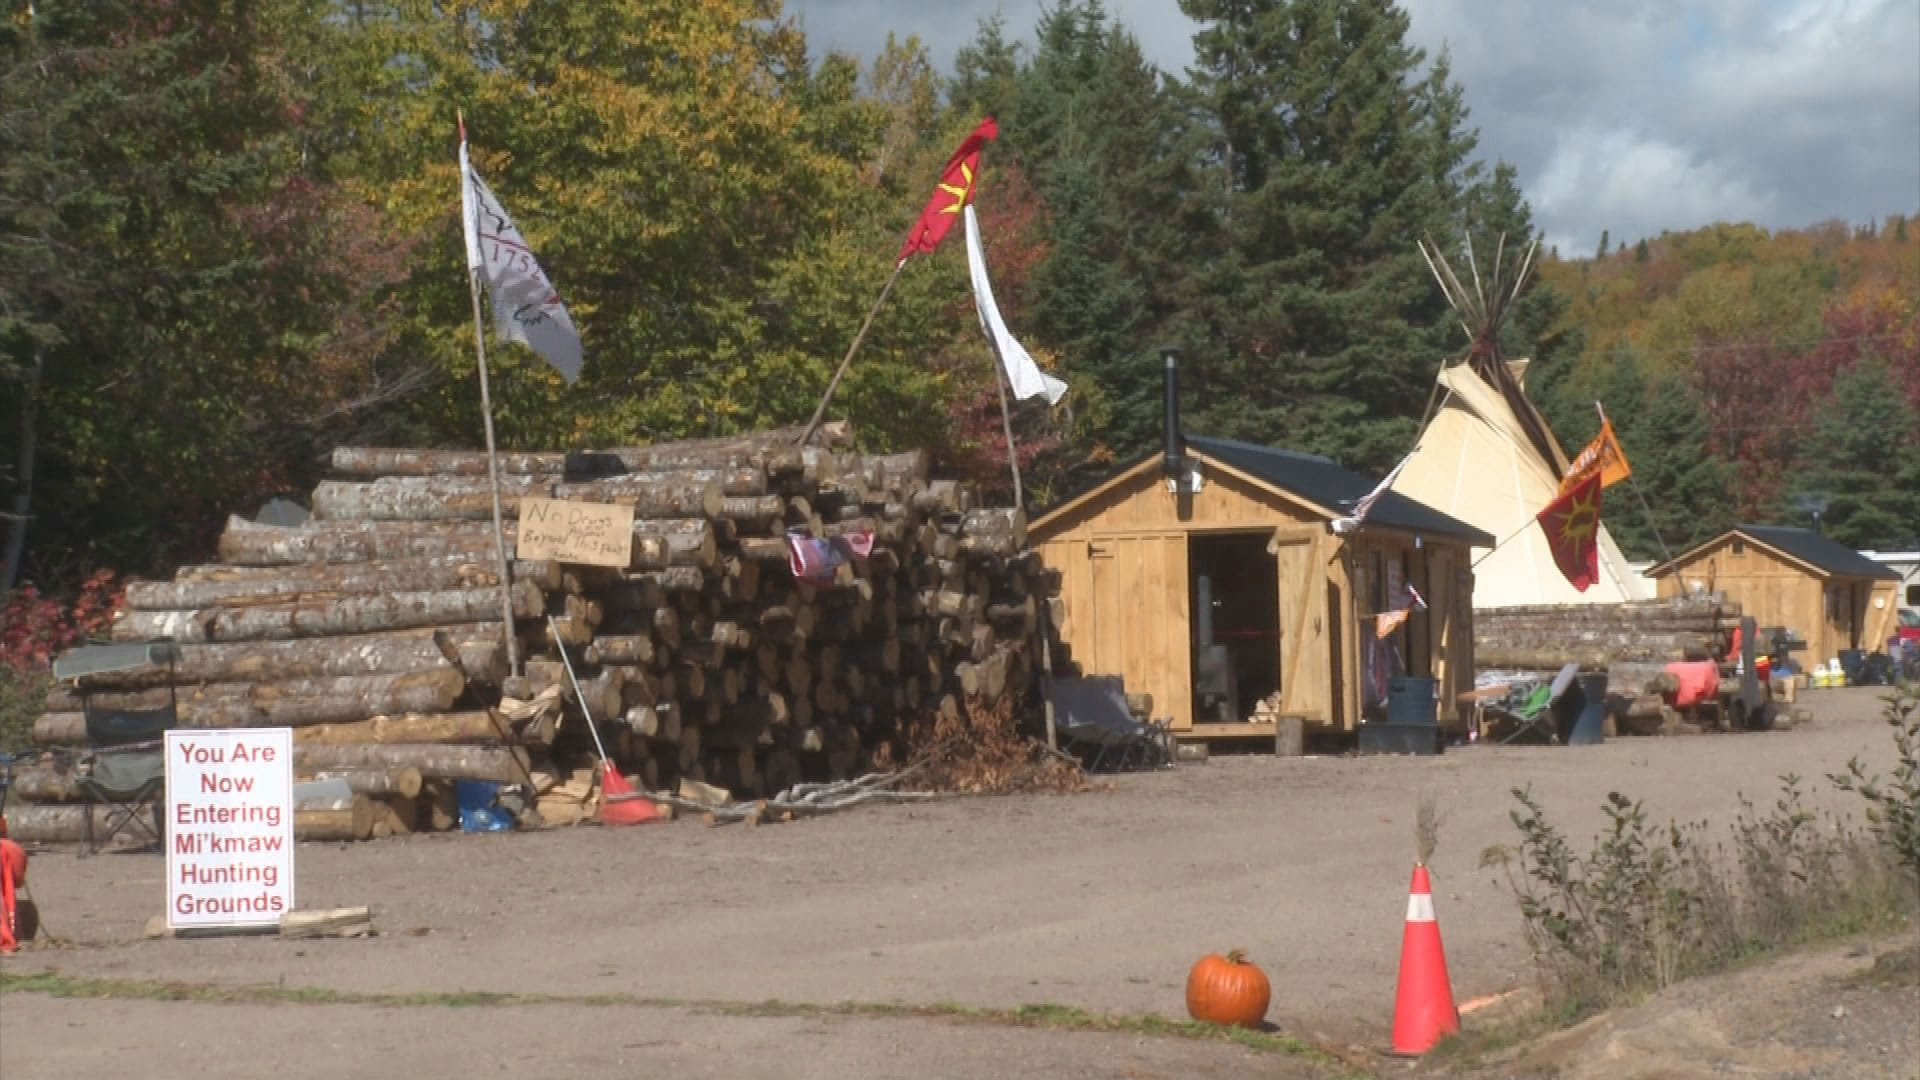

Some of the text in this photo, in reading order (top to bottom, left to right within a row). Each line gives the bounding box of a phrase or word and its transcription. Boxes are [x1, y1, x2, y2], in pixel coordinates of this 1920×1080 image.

[491, 243, 541, 281] 1752
[526, 503, 563, 523] No
[179, 742, 276, 764] You Are
[201, 772, 255, 793] Now
[176, 802, 281, 826] Entering
[175, 832, 284, 855] Mi'kmaw
[180, 862, 278, 887] Hunting
[175, 892, 284, 915] Grounds
